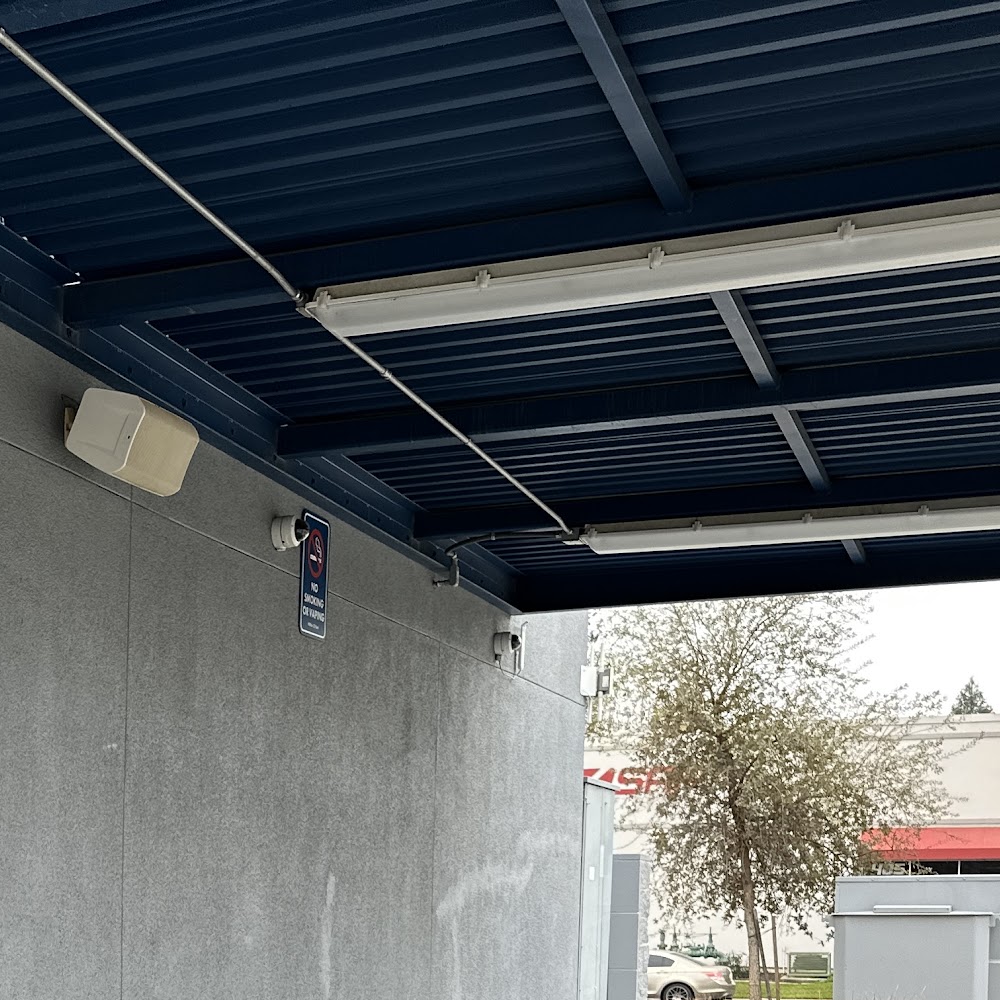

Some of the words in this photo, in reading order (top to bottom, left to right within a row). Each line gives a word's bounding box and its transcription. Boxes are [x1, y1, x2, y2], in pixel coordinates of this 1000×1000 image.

[311, 582, 319, 593] NO
[304, 592, 324, 609] SMOKING
[309, 607, 324, 622] VAPING
